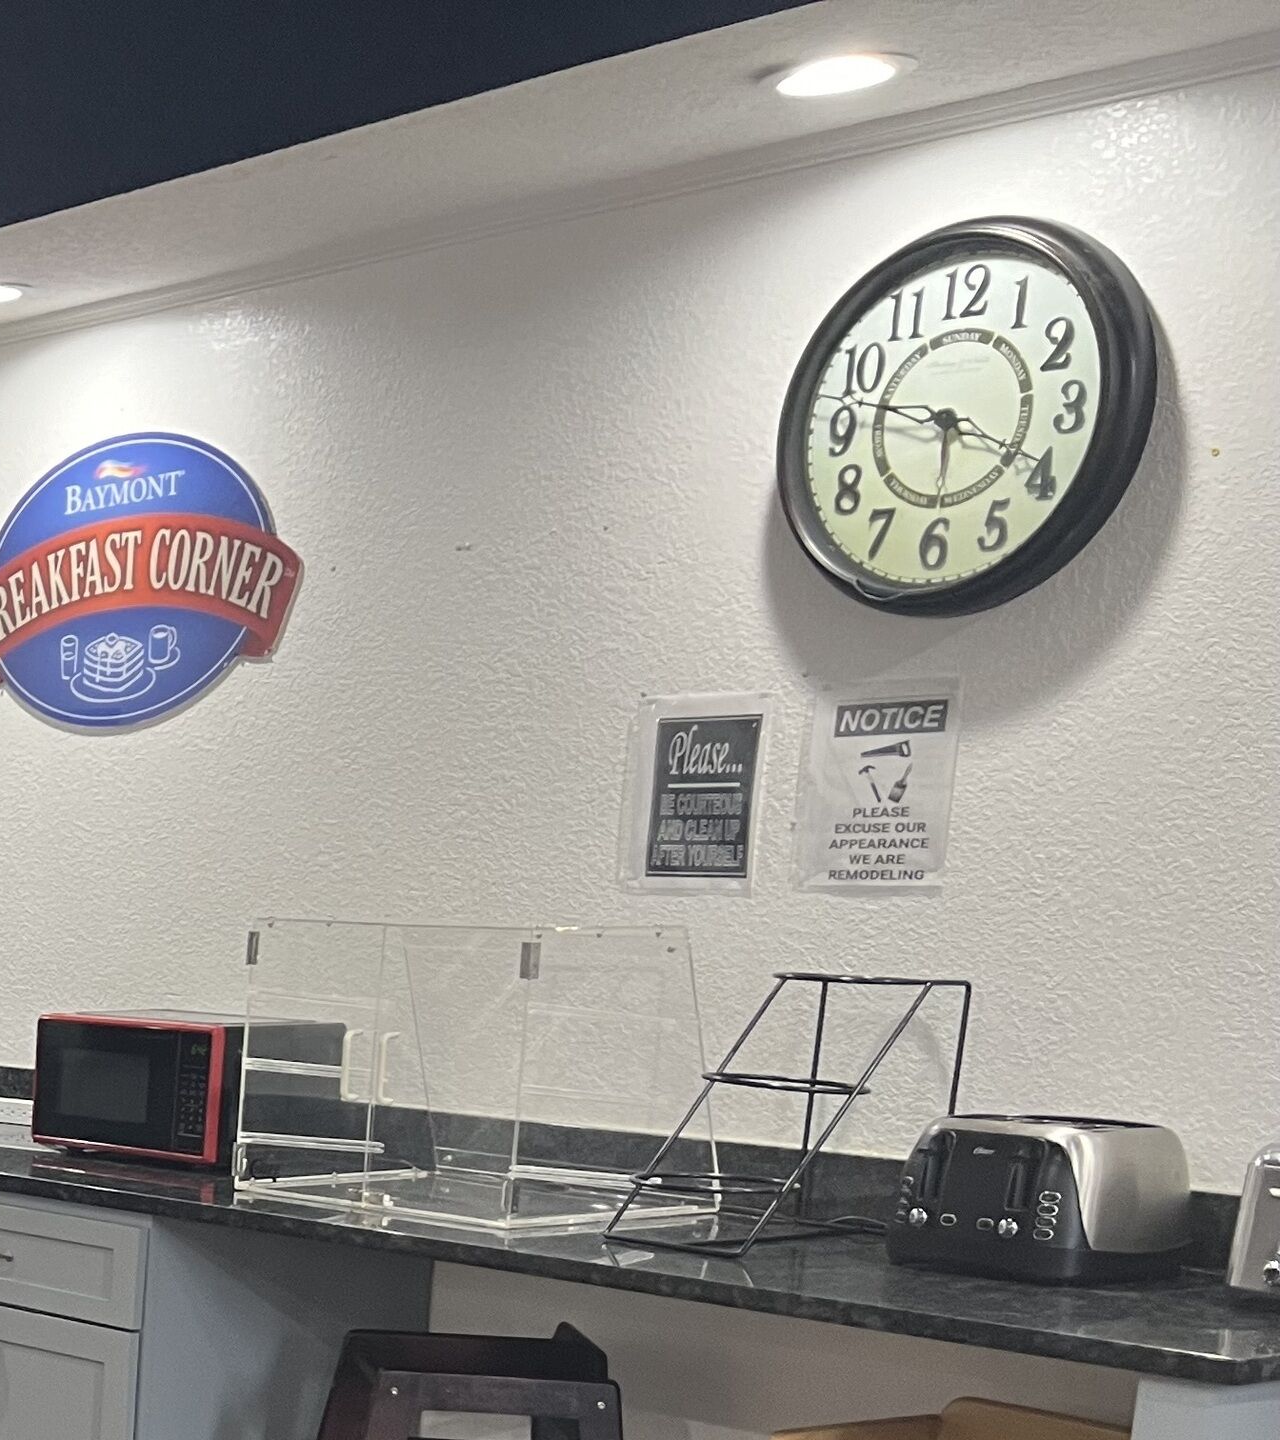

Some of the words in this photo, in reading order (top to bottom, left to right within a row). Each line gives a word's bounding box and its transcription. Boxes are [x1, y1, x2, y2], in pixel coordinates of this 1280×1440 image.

[887, 286, 925, 341] 11
[942, 264, 991, 321] 12
[1010, 275, 1029, 329] 1
[941, 332, 982, 345] SUNDAY
[999, 343, 1028, 381] MONDAY
[1040, 316, 1075, 372] 2
[843, 342, 886, 396] 10
[829, 405, 857, 457] 9
[1053, 379, 1087, 434] 3
[64, 471, 182, 515] BAYMONT
[834, 464, 862, 516] 8
[1024, 446, 1057, 501] 4
[868, 507, 896, 560] 7
[919, 517, 950, 571] 6
[977, 497, 1011, 552] 5
[149, 528, 284, 620] CORNER
[840, 704, 944, 732] NOTICE
[668, 724, 742, 775] Please...
[657, 819, 683, 841] AND
[684, 819, 723, 841] CLEAN
[724, 819, 741, 841] UP
[659, 793, 676, 816] BE
[677, 793, 743, 816] COURTEOUS
[834, 822, 889, 834] EXCUSE
[894, 822, 927, 833] OUR
[852, 806, 910, 818] PLEASE
[651, 844, 686, 866] AFTER
[688, 844, 744, 867] YOURSELF
[828, 837, 930, 850] APPEARANCE
[848, 854, 871, 865] WE
[874, 854, 906, 865] ARE
[828, 869, 926, 881] REMODELING
